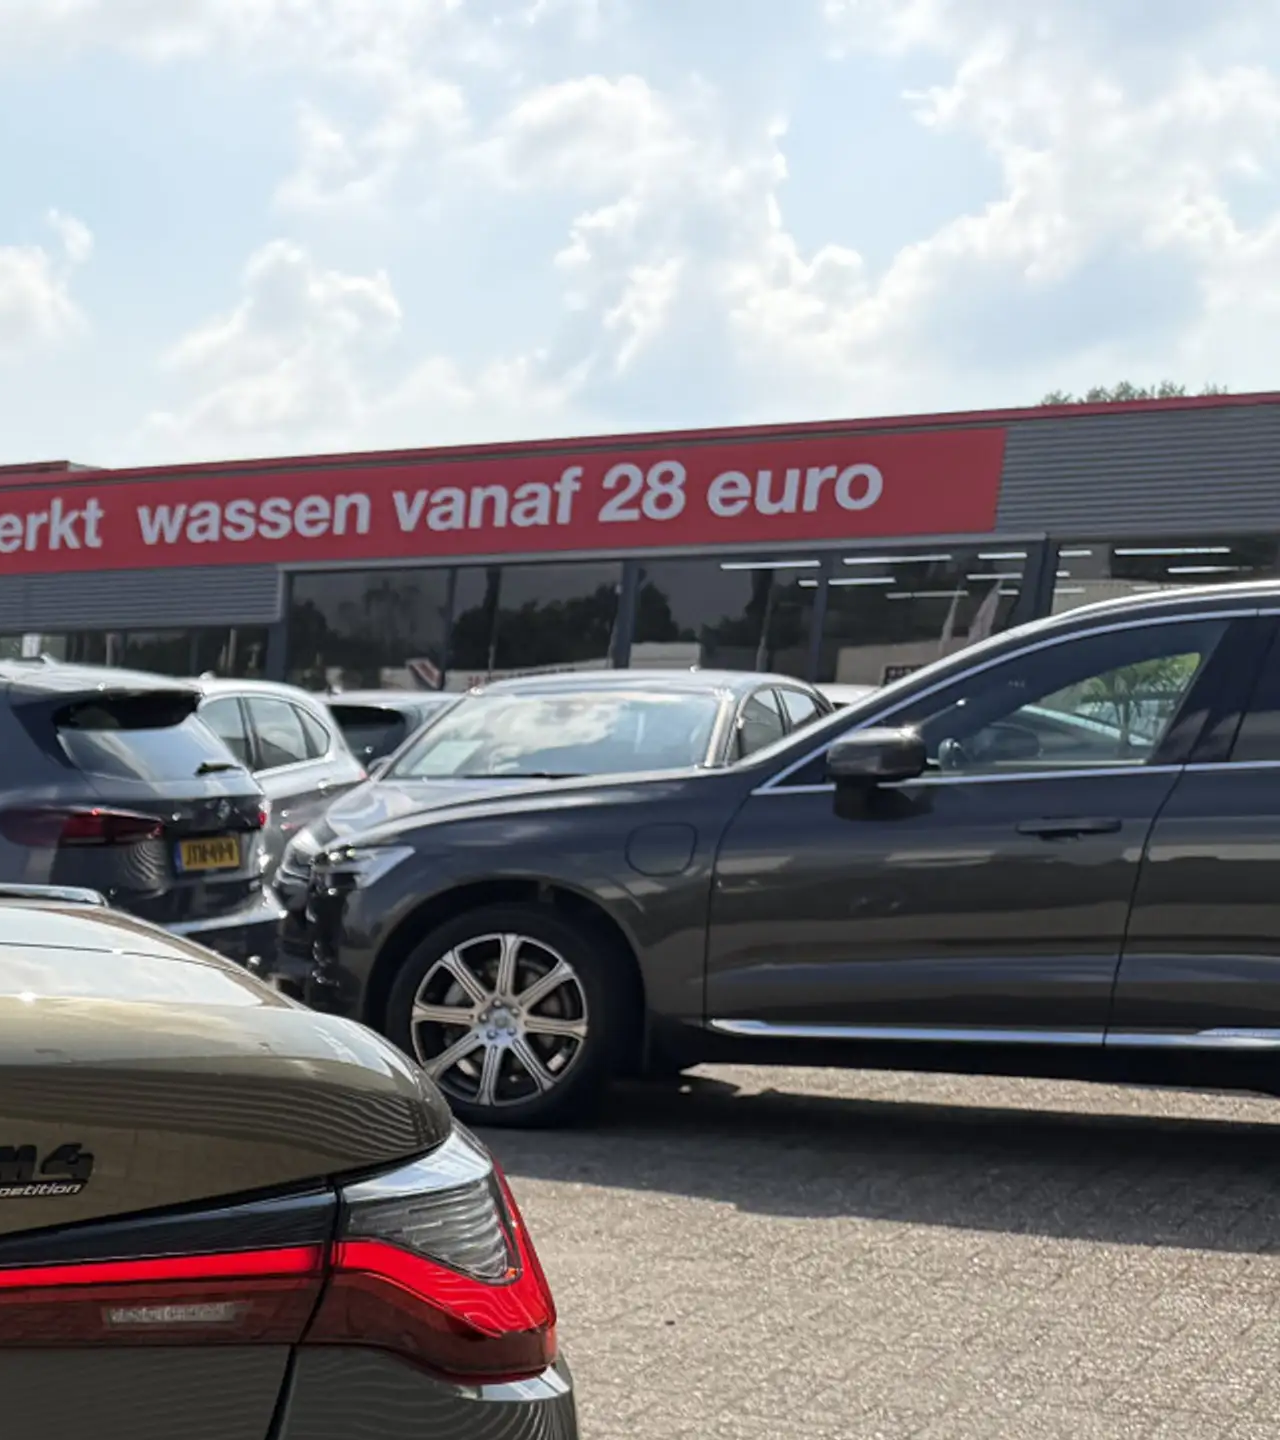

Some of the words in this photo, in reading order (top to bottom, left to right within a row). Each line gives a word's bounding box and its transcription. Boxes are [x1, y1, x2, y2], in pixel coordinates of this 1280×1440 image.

[137, 491, 371, 545] wassen
[392, 466, 584, 533] vanaf
[598, 460, 688, 522] 28
[706, 462, 884, 517] euro
